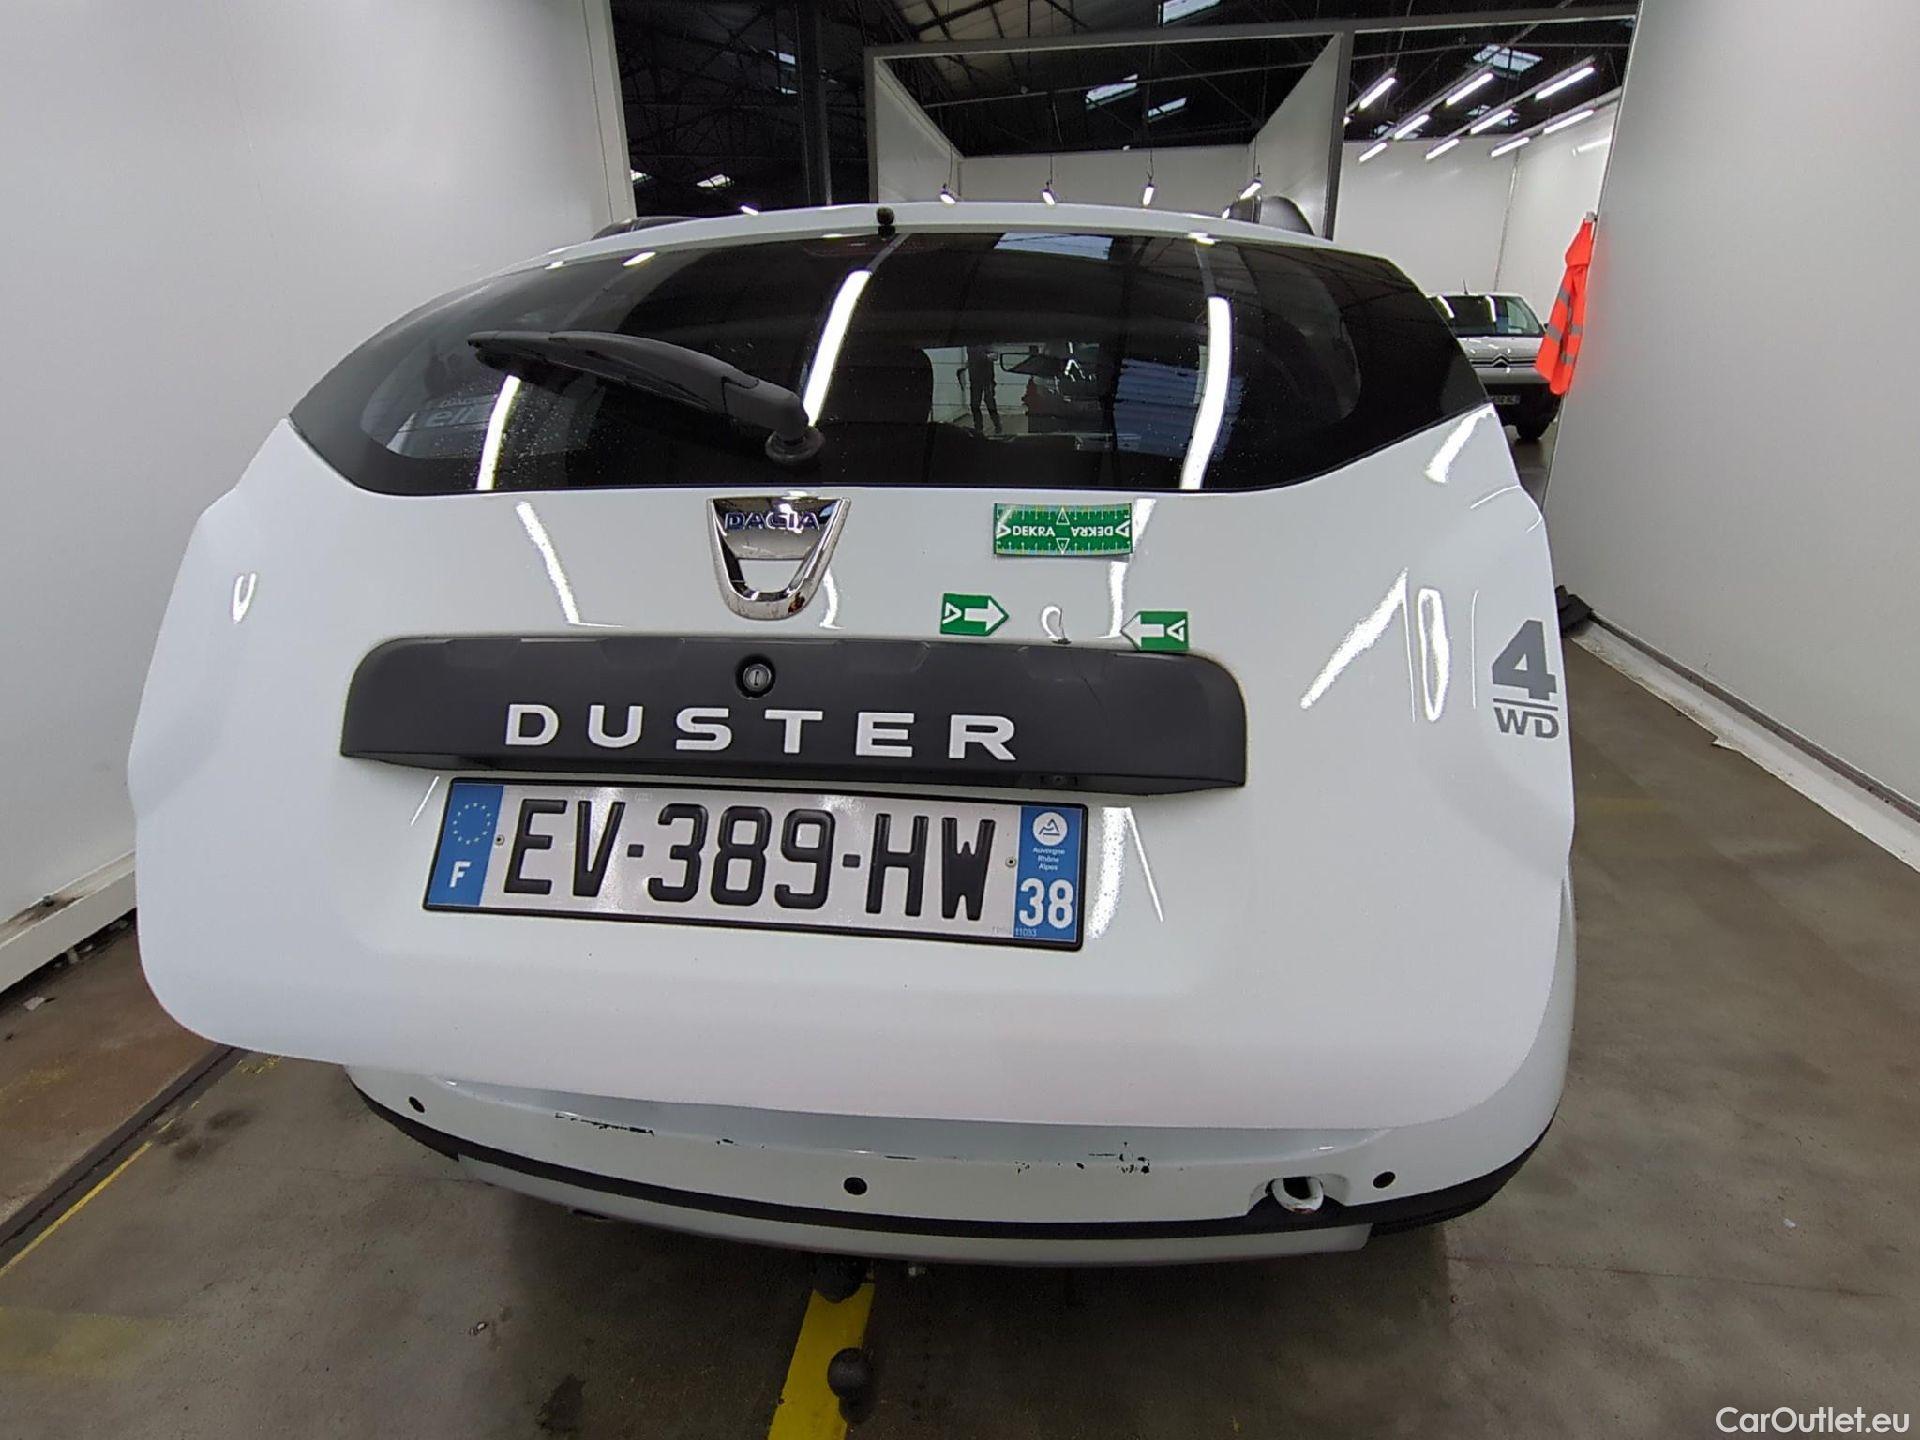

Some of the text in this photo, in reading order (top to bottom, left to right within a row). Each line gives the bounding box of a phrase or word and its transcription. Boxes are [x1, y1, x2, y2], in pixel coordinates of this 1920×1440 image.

[724, 512, 819, 531] DACIA
[1012, 525, 1114, 537] DEKRA DEKRA
[1492, 619, 1557, 701] 4
[505, 703, 1016, 761] DUSTER
[1493, 706, 1560, 739] WD
[503, 798, 996, 922] EV-389-HW
[1033, 847, 1065, 855] Auvergne
[1038, 855, 1060, 864] Rhône
[449, 861, 472, 888] F
[1038, 864, 1059, 872] Alpes
[1019, 877, 1074, 930] 38
